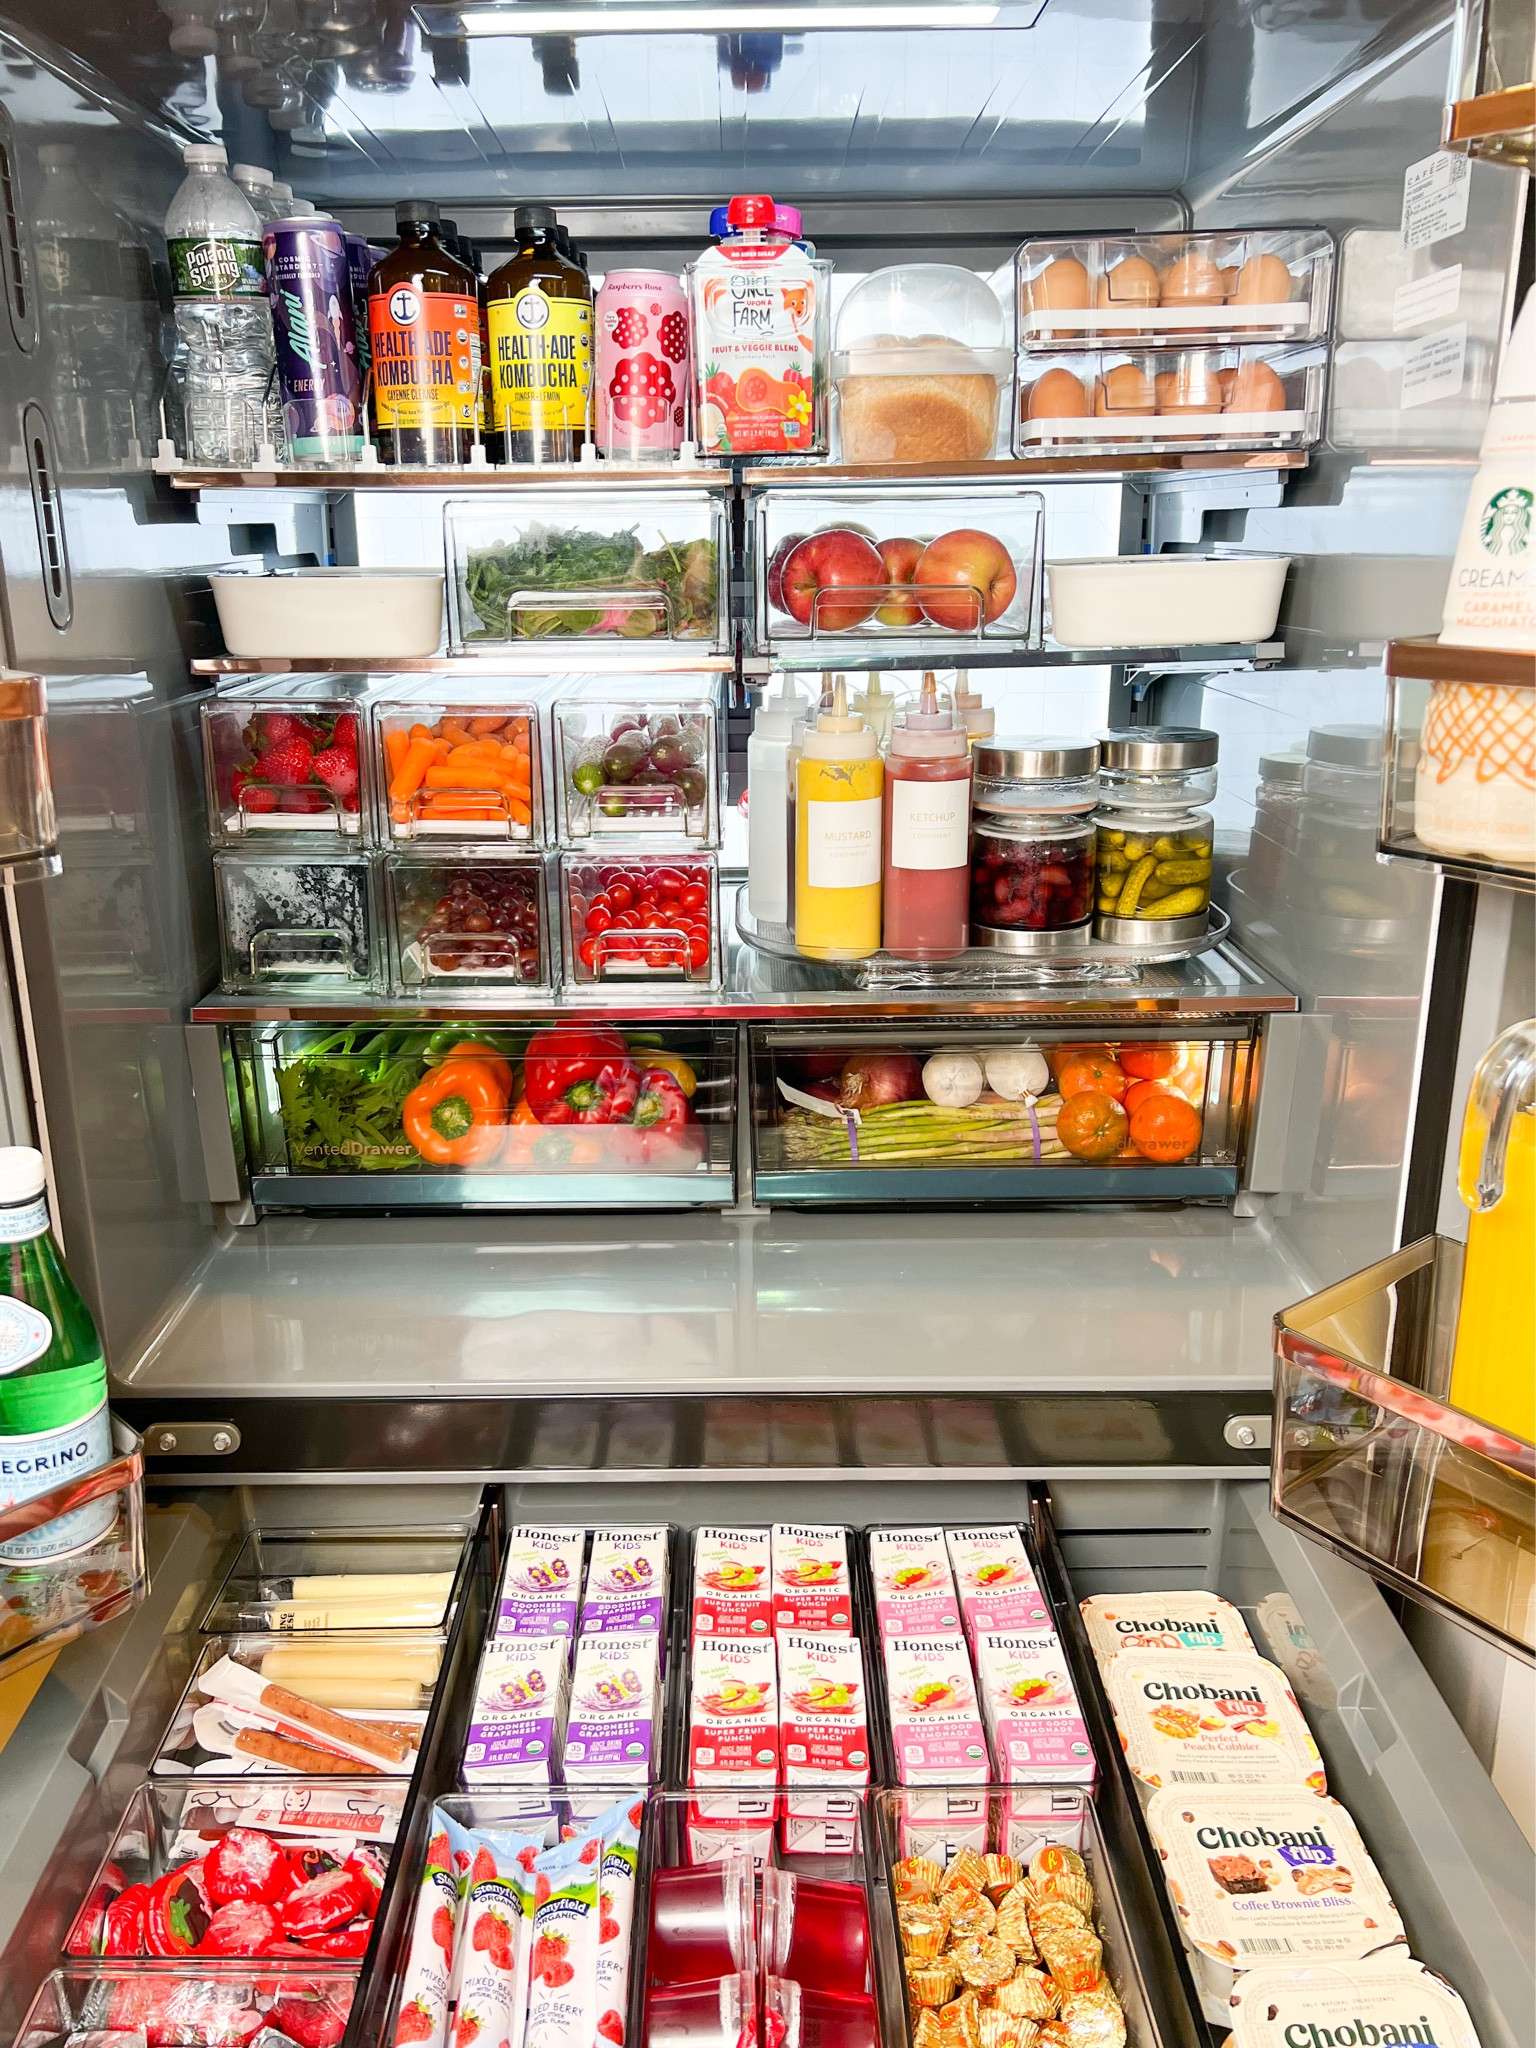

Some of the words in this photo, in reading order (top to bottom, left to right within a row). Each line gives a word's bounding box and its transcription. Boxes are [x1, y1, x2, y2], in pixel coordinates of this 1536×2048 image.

[1407, 162, 1435, 186] CAFÉ
[186, 244, 237, 270] Poland
[189, 262, 240, 287] Spring
[608, 283, 643, 292] Raspberry
[644, 283, 663, 292] Rose
[280, 288, 327, 370] Alani
[712, 345, 732, 354] FRUIT
[734, 344, 740, 352] &
[741, 344, 773, 352] VEGGIE
[774, 344, 799, 353] BLEND
[377, 359, 454, 387] KOMBUCHA
[500, 362, 578, 389] KOMBUCHA
[294, 379, 326, 392] ENERY
[387, 389, 410, 401] CAYENNE
[411, 389, 439, 400] CLEANSE
[1458, 568, 1536, 588] CREAM
[1464, 601, 1534, 613] CARAMEL
[910, 812, 956, 822] KETCHUP
[824, 830, 872, 842] MUSTARD
[293, 1141, 413, 1156] VentedDrawer
[516, 1529, 580, 1543] Honest
[598, 1531, 661, 1542] Honest
[704, 1529, 768, 1543] Honest
[780, 1526, 843, 1539] Honest
[878, 1532, 942, 1543] Honest
[953, 1530, 1017, 1541] Honest
[511, 1592, 567, 1600] ORGANIC
[706, 1591, 761, 1599] ORGANIC
[890, 1590, 946, 1601] ORGANIC
[975, 1585, 1031, 1596] ORGANIC
[596, 1592, 651, 1601] ORGANIC
[598, 1600, 646, 1611] GOODNESS
[705, 1599, 732, 1608] SUPER
[895, 1604, 945, 1614] LEMONADE
[982, 1599, 1031, 1610] LEMONADE
[596, 1605, 646, 1616] GRAPENESS
[280, 1613, 288, 1631] ING
[287, 1612, 295, 1631] ESE
[1115, 1618, 1220, 1634] Chobani
[488, 1639, 560, 1654] Honest
[581, 1638, 652, 1651] Honest
[702, 1640, 772, 1655] Honest
[788, 1637, 858, 1654] Honest
[893, 1640, 965, 1652] Honest
[987, 1636, 1058, 1649] Honest
[1143, 1682, 1263, 1703] Chobani
[481, 1710, 542, 1721] ORGANIC
[579, 1710, 640, 1720] ORGANIC
[908, 1713, 971, 1723] ORGANIC
[1010, 1709, 1073, 1718] ORGANIC
[706, 1716, 767, 1725] ORGANIC
[795, 1715, 857, 1724] ORGANIC
[482, 1721, 536, 1731] GOODNESS
[581, 1722, 634, 1731] GOODNESS
[794, 1726, 825, 1734] SUPER
[828, 1727, 857, 1735] FRUIT
[909, 1725, 940, 1733] BERRY
[1018, 1726, 1073, 1734] LEMONADE
[480, 1727, 536, 1738] GRAPENESS
[579, 1728, 635, 1738] GRAPENESS
[705, 1728, 735, 1736] SUPER
[914, 1730, 970, 1739] LEMONADE
[808, 1734, 843, 1742] PUNCH
[1201, 1734, 1239, 1742] Perfect
[1014, 1743, 1025, 1751] 35
[1183, 1742, 1215, 1751] Peach
[1197, 1826, 1329, 1850] Chobani
[1289, 1846, 1332, 1864] flip.
[602, 1855, 631, 1874] yfield
[602, 1869, 623, 1879] ANIC
[474, 1884, 523, 1913] Stonyfield
[1232, 1900, 1269, 1911] Coffee
[1272, 1897, 1321, 1910] Brownie
[465, 1977, 495, 1988] MIXED
[553, 2002, 584, 2016] BERRY
[1284, 2015, 1436, 2048] Chobani
